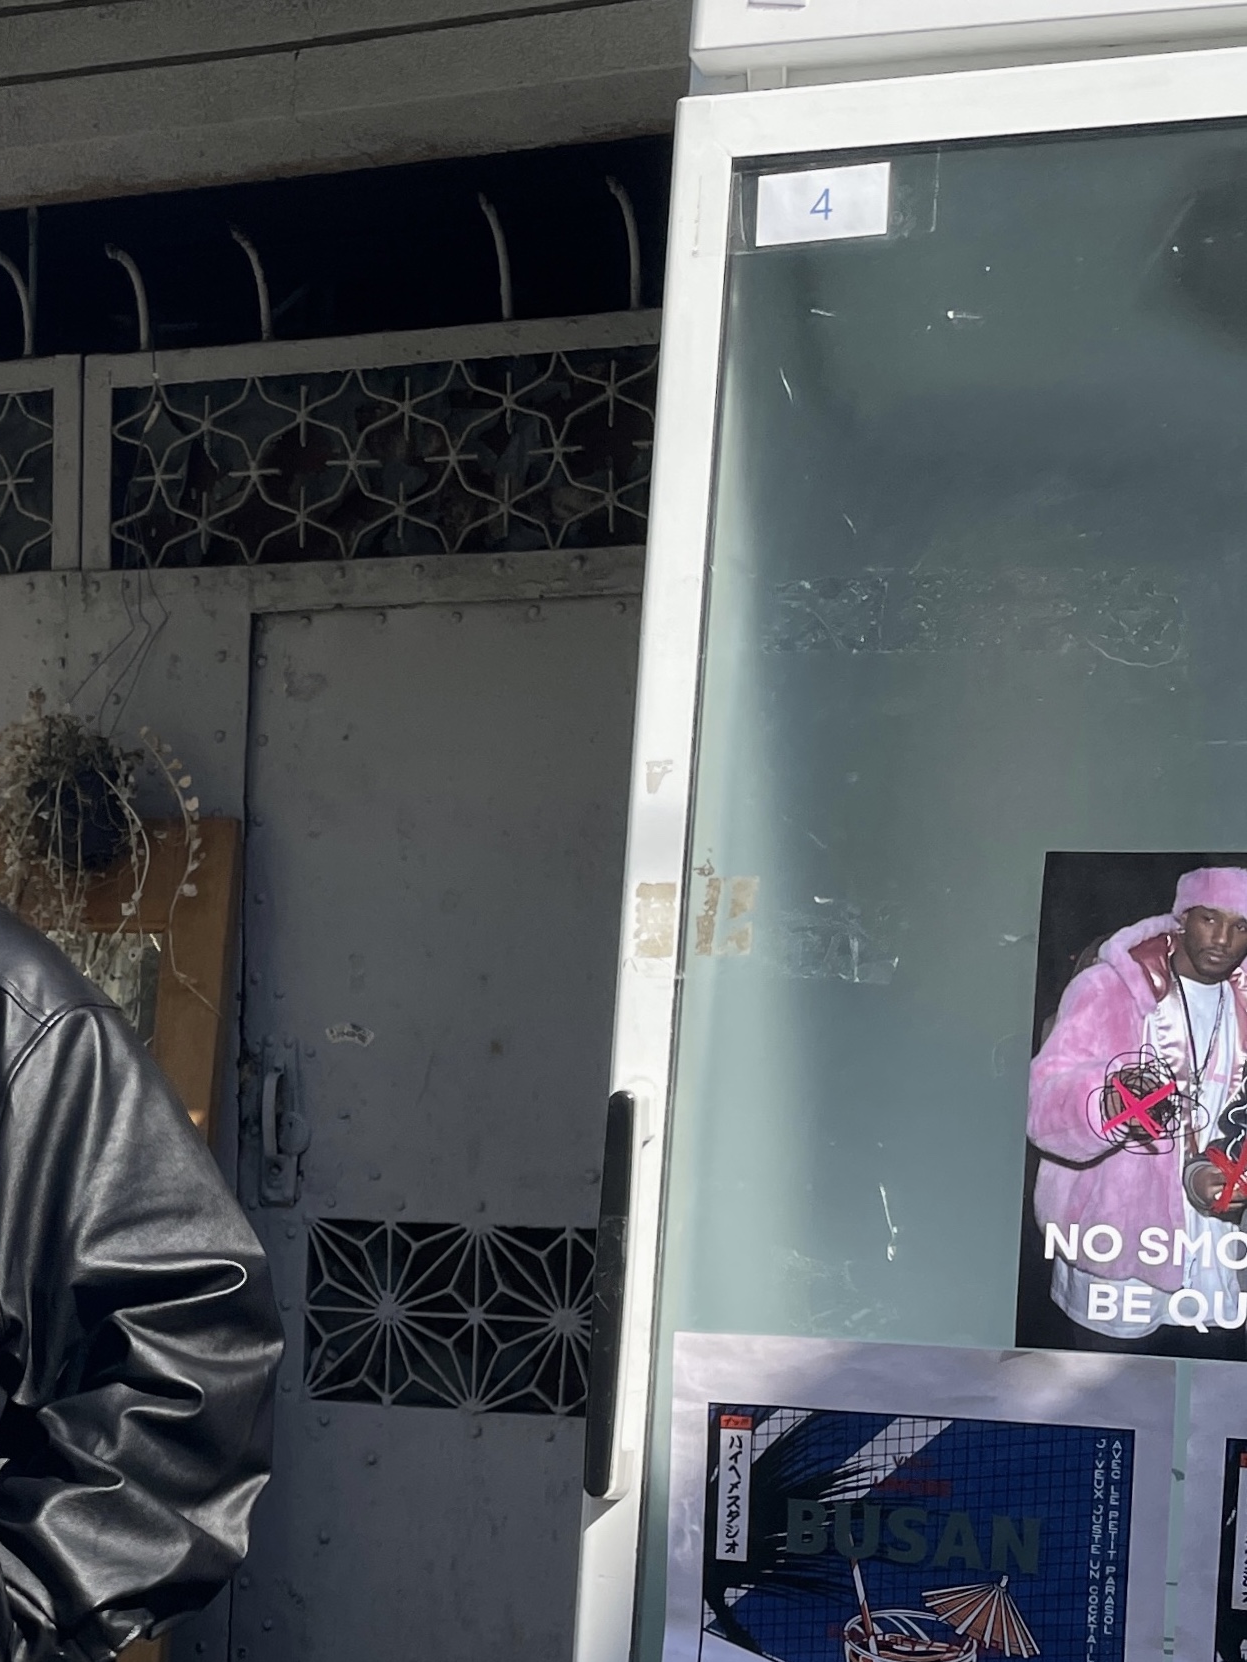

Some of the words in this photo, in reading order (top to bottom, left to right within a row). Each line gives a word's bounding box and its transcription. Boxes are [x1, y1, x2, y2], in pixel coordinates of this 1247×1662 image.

[809, 188, 834, 220] 4
[1044, 1222, 1123, 1262] NO
[1138, 1226, 1247, 1270] SMO
[1087, 1283, 1153, 1323] BE
[1168, 1288, 1247, 1334] QU
[1111, 1440, 1122, 1479] AVEC
[1109, 1485, 1120, 1505] LE
[786, 1498, 1042, 1575] BUSAN
[1090, 1504, 1104, 1555] JUSTE
[1107, 1511, 1119, 1560] PETIT
[1089, 1559, 1101, 1580] UN
